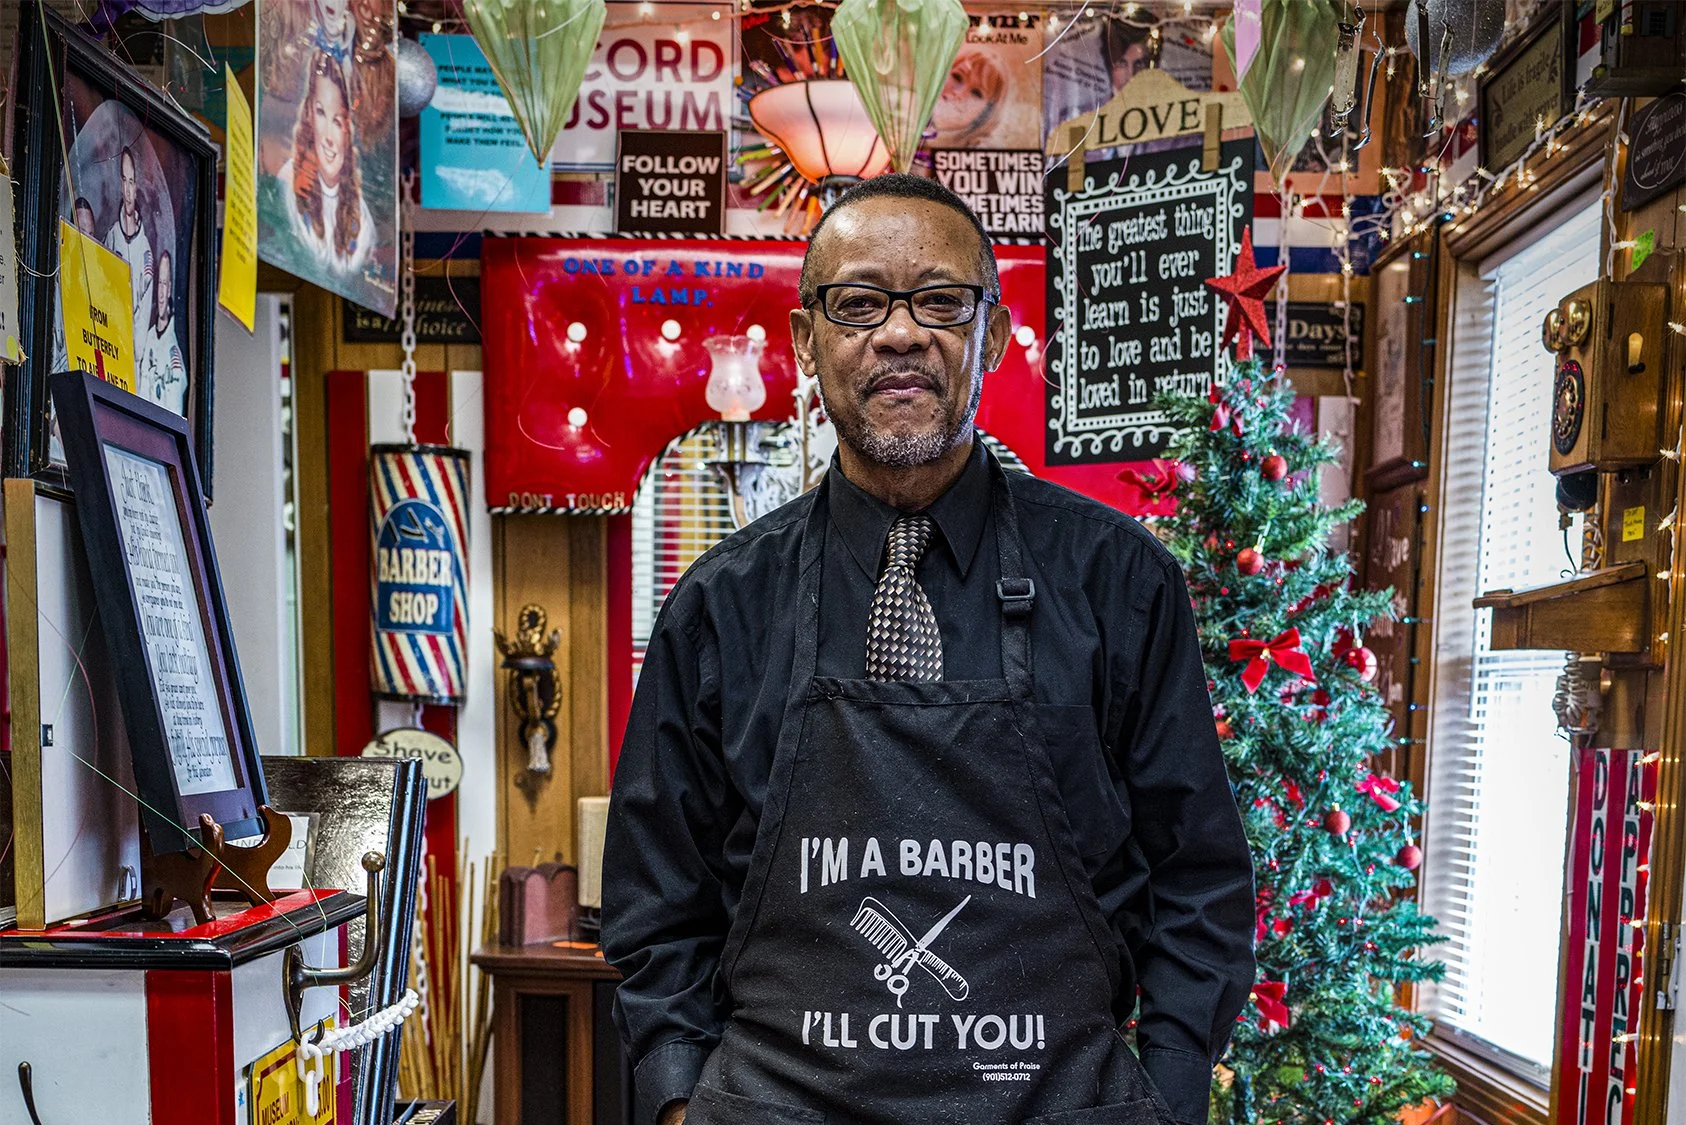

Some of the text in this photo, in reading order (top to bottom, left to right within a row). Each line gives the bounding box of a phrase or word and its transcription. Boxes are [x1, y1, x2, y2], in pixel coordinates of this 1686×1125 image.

[1096, 98, 1201, 145] LOVE
[622, 155, 720, 174] FOLLOW
[935, 151, 1042, 171] SOMETIMES
[638, 178, 706, 197] YOUR
[936, 170, 1044, 195] YOU WIN
[631, 199, 711, 219] HEART
[981, 213, 1045, 232] LEARN
[1077, 202, 1214, 254] The greatest thing
[563, 257, 765, 279] ONE OF A KIND
[1091, 249, 1200, 296] you'll ever
[631, 286, 714, 308] LAMP.
[1082, 283, 1209, 331] learn is just
[89, 304, 108, 328] FROM
[1288, 318, 1346, 343] Days
[82, 328, 119, 360] BUTTERFLY
[1080, 326, 1212, 371] to love and be
[1079, 374, 1121, 410] loved
[1128, 372, 1148, 405] in
[508, 491, 626, 510] DONT TOUCH
[379, 548, 453, 586] BARBER
[389, 592, 438, 625] SHOP
[373, 740, 453, 764] Shave
[800, 837, 1036, 899] I'M A BARBER
[802, 1010, 1046, 1050] I'LL CUT YOU!
[973, 1062, 1041, 1070] Garments of Praise
[982, 1072, 1031, 1081] (901)512-0712
